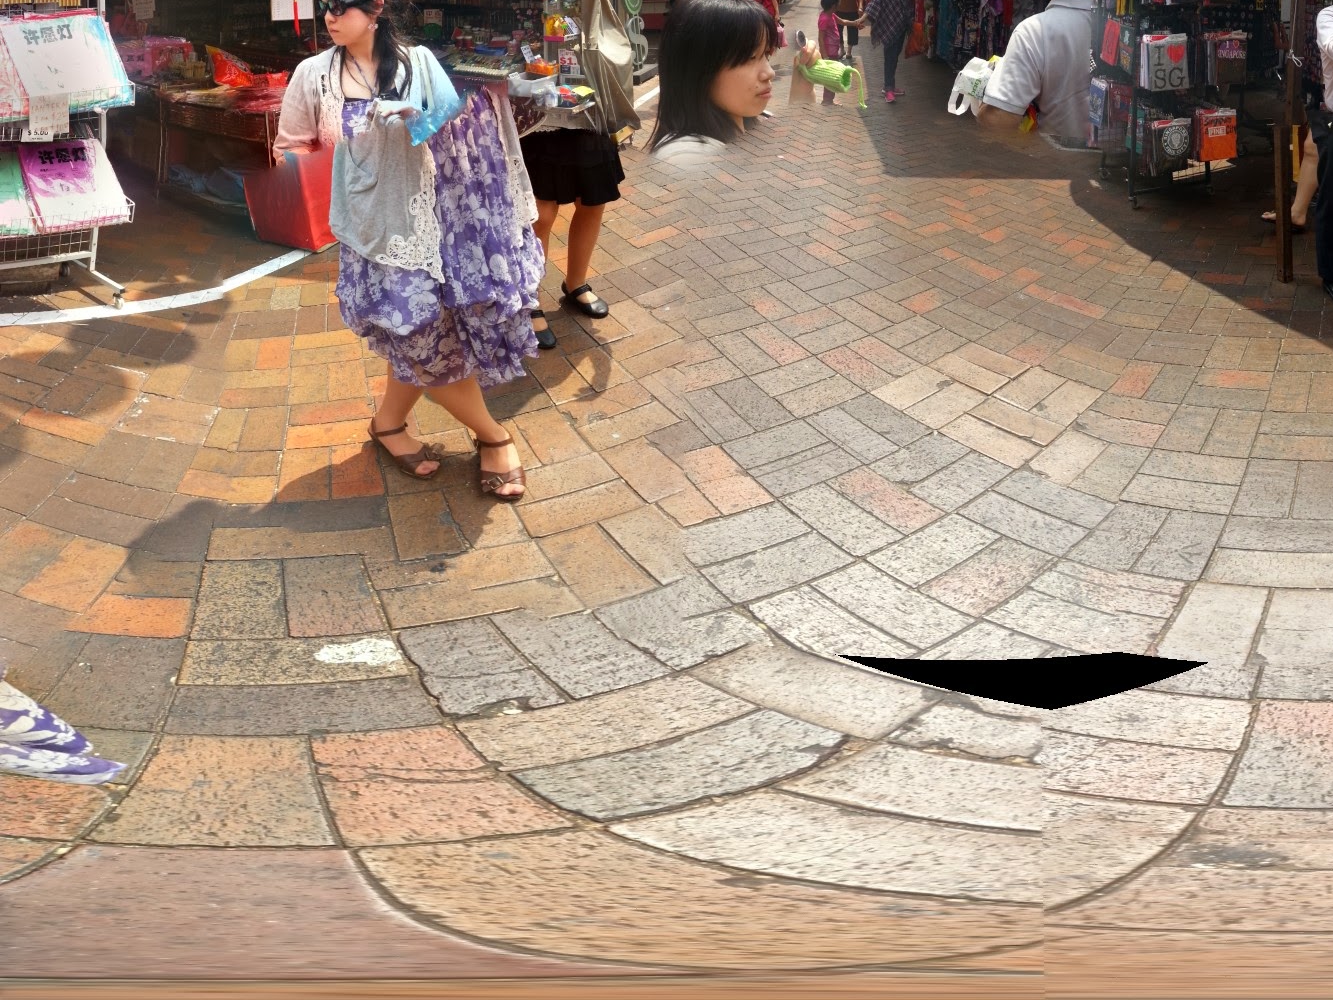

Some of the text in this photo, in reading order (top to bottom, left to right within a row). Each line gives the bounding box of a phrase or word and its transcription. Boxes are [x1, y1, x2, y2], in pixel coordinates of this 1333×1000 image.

[23, 23, 73, 46] 许愿灯
[1154, 67, 1185, 90] SG
[1163, 125, 1189, 141] SINGAPORE
[1210, 127, 1226, 136] FINE
[38, 147, 87, 164] 许愿灯
